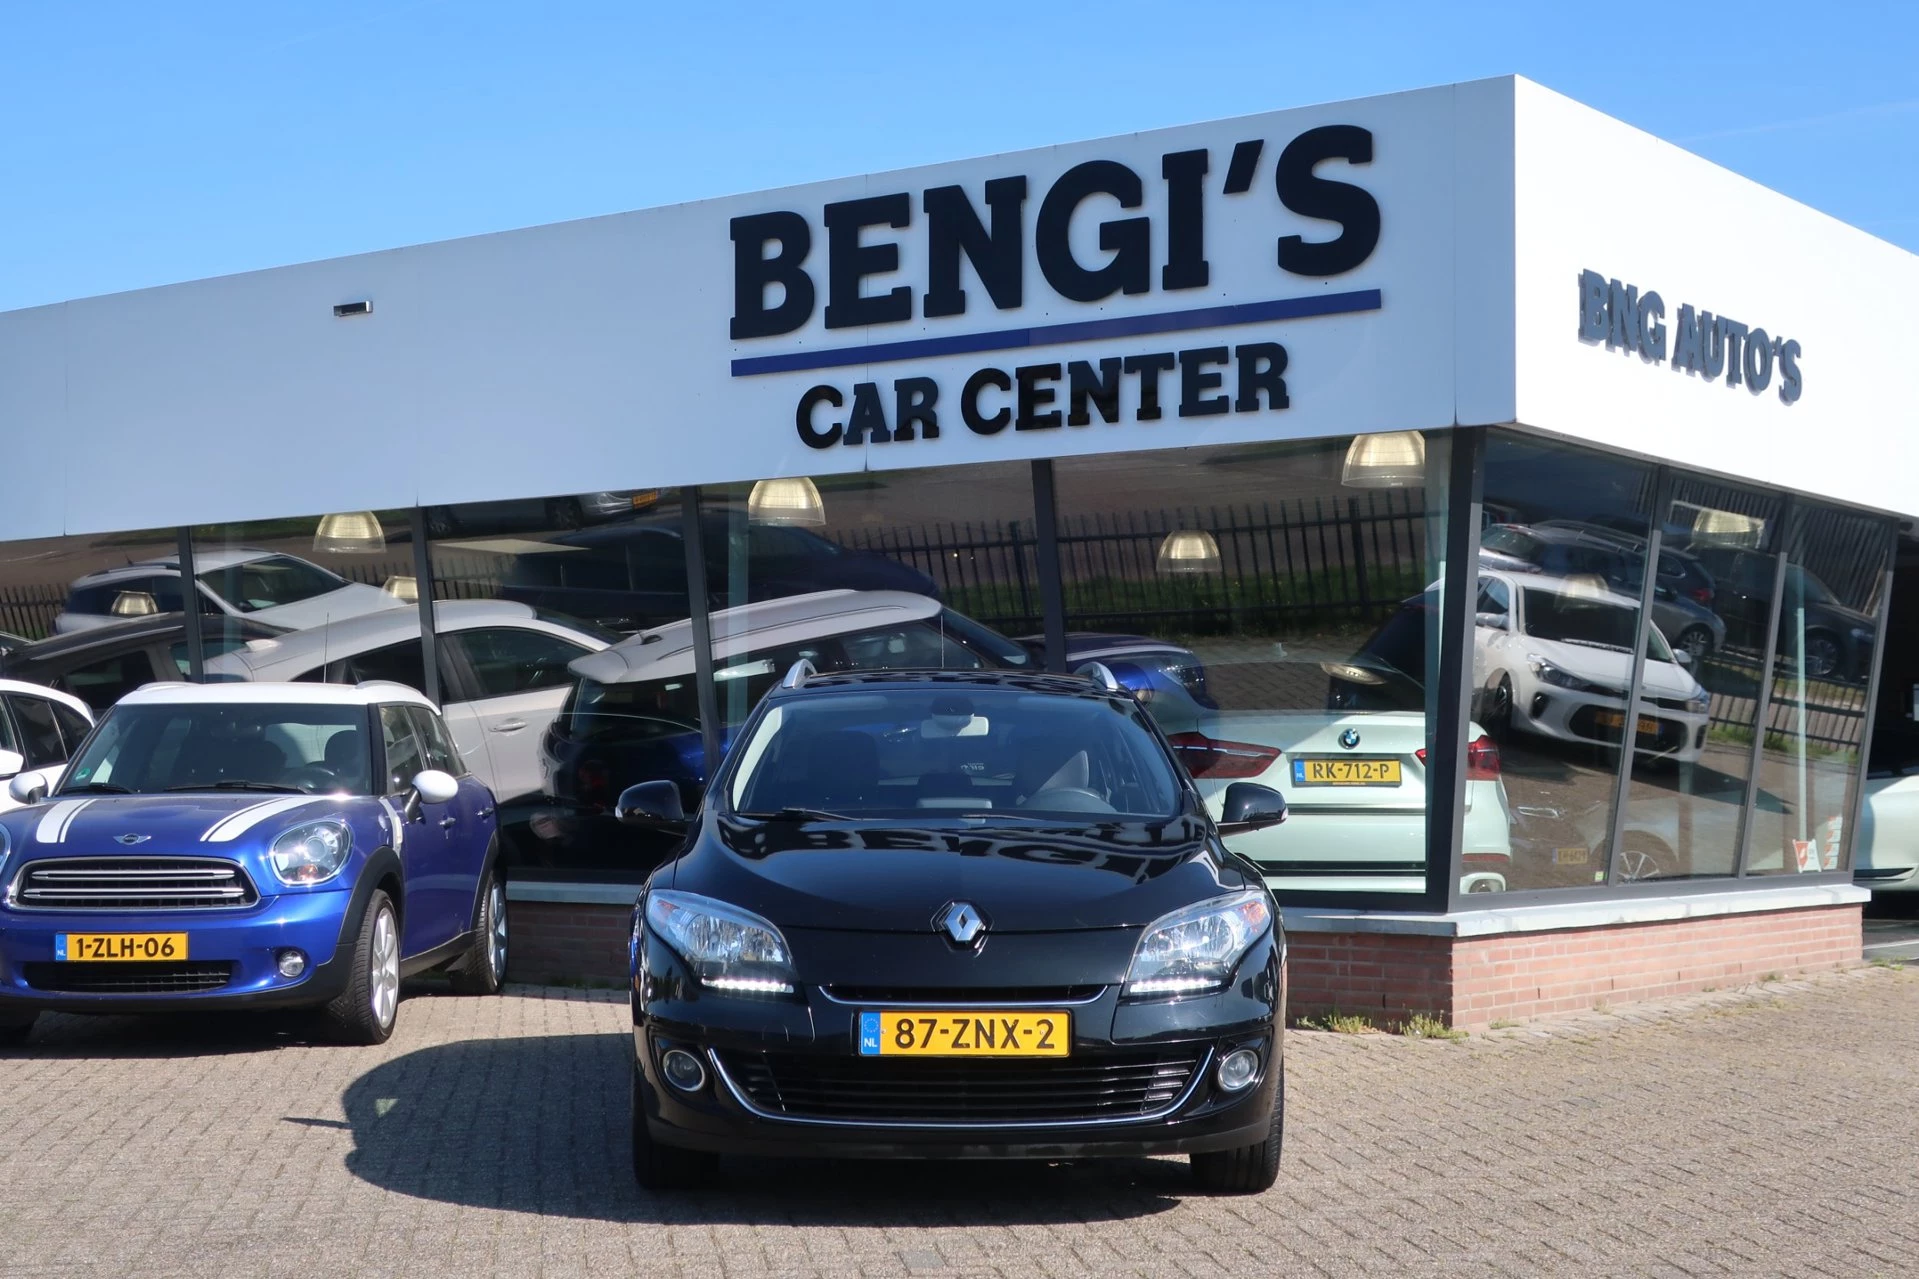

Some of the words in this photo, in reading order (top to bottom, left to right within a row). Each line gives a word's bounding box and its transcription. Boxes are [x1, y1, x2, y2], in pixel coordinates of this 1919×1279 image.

[729, 124, 1381, 340] BENGI'S
[1578, 268, 1667, 366] BNG
[1671, 303, 1802, 406] AUTO'S
[796, 376, 940, 450] CAR
[960, 342, 1290, 435] CENTER
[1313, 763, 1390, 779] RK-712-P
[76, 937, 175, 958] 1-ZLH-06
[863, 1038, 878, 1048] NL
[895, 1018, 1055, 1050] 87-ZNX-2
